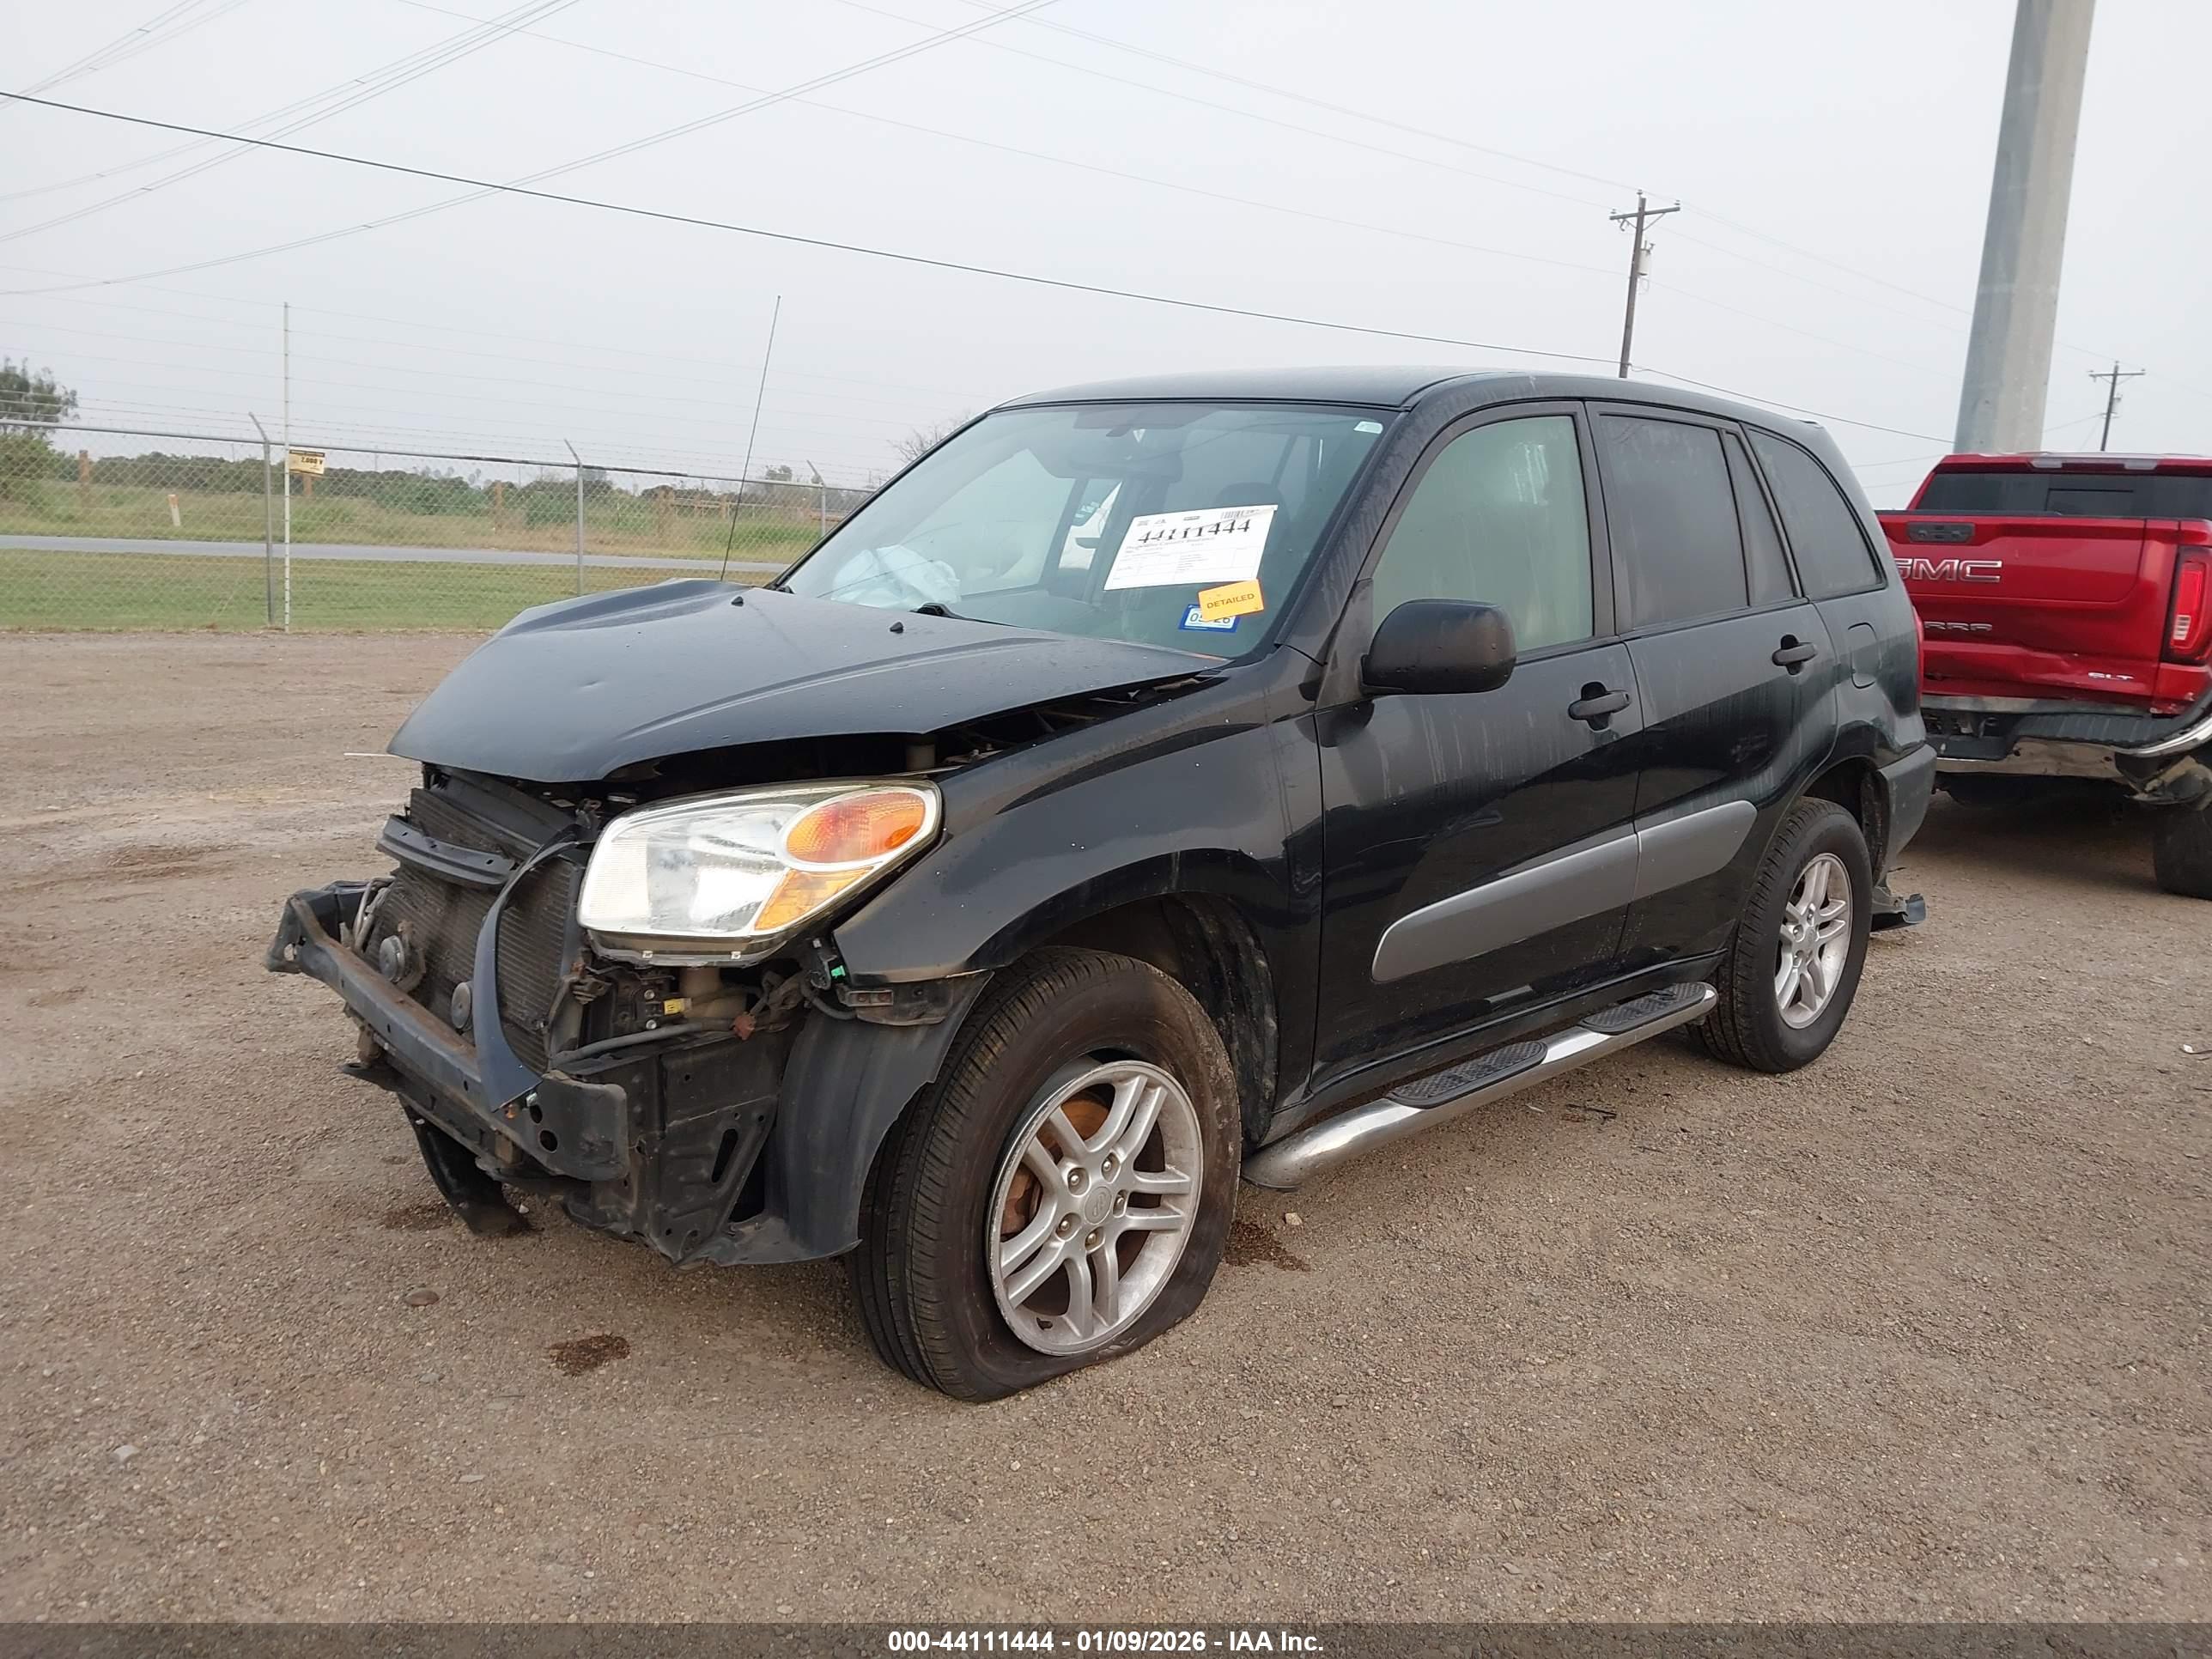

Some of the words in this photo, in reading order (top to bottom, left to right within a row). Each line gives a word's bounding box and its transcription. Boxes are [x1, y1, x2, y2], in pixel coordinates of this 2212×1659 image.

[1138, 519, 1251, 544] 44111444
[1206, 593, 1255, 609] DETAILED
[2087, 672, 2135, 680] SLT
